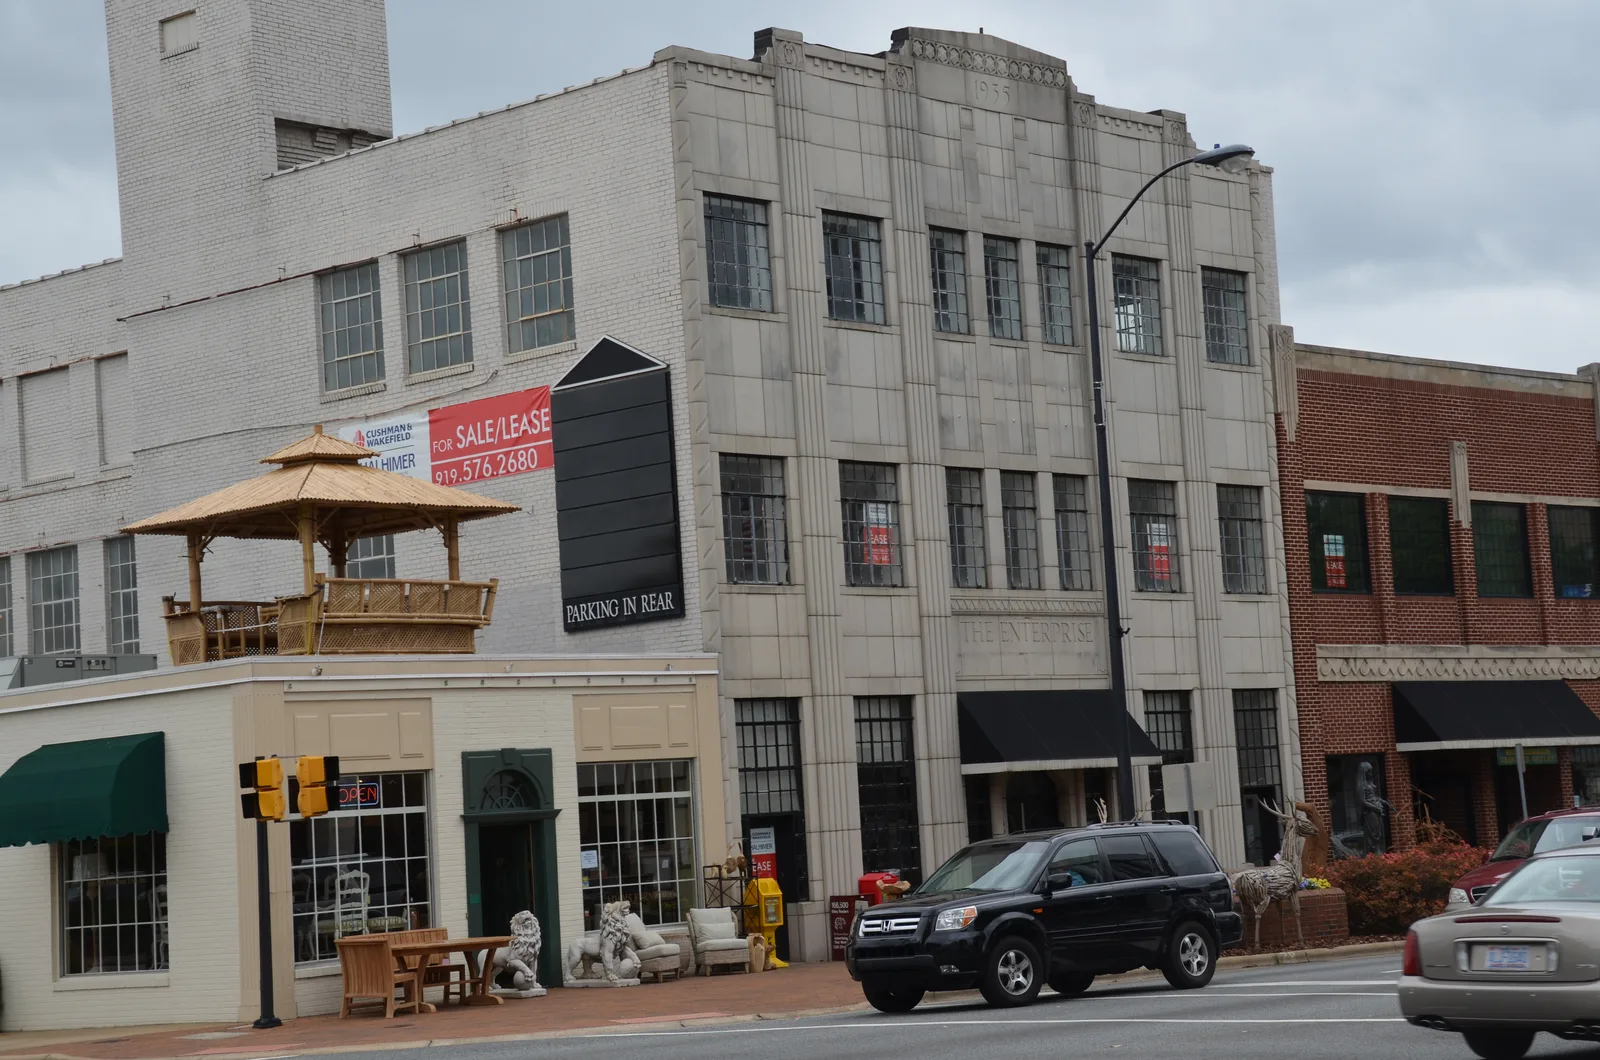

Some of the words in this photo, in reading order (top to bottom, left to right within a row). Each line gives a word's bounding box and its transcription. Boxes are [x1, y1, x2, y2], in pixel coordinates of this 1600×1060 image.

[974, 79, 1010, 108] 1935
[366, 424, 406, 438] CUSHMAN
[406, 422, 413, 431] &
[366, 432, 412, 448] WAKEFIELD
[433, 439, 453, 454] FOR
[456, 407, 550, 449] SALE/LEASE
[435, 447, 538, 486] 919.576.2680
[566, 599, 620, 624] PARKING
[622, 595, 638, 616] IN
[641, 591, 675, 613] REAR
[960, 621, 994, 643] THE
[1000, 621, 1094, 643] ENTERPRISE
[338, 787, 377, 803] OPEN
[752, 861, 772, 872] EASE
